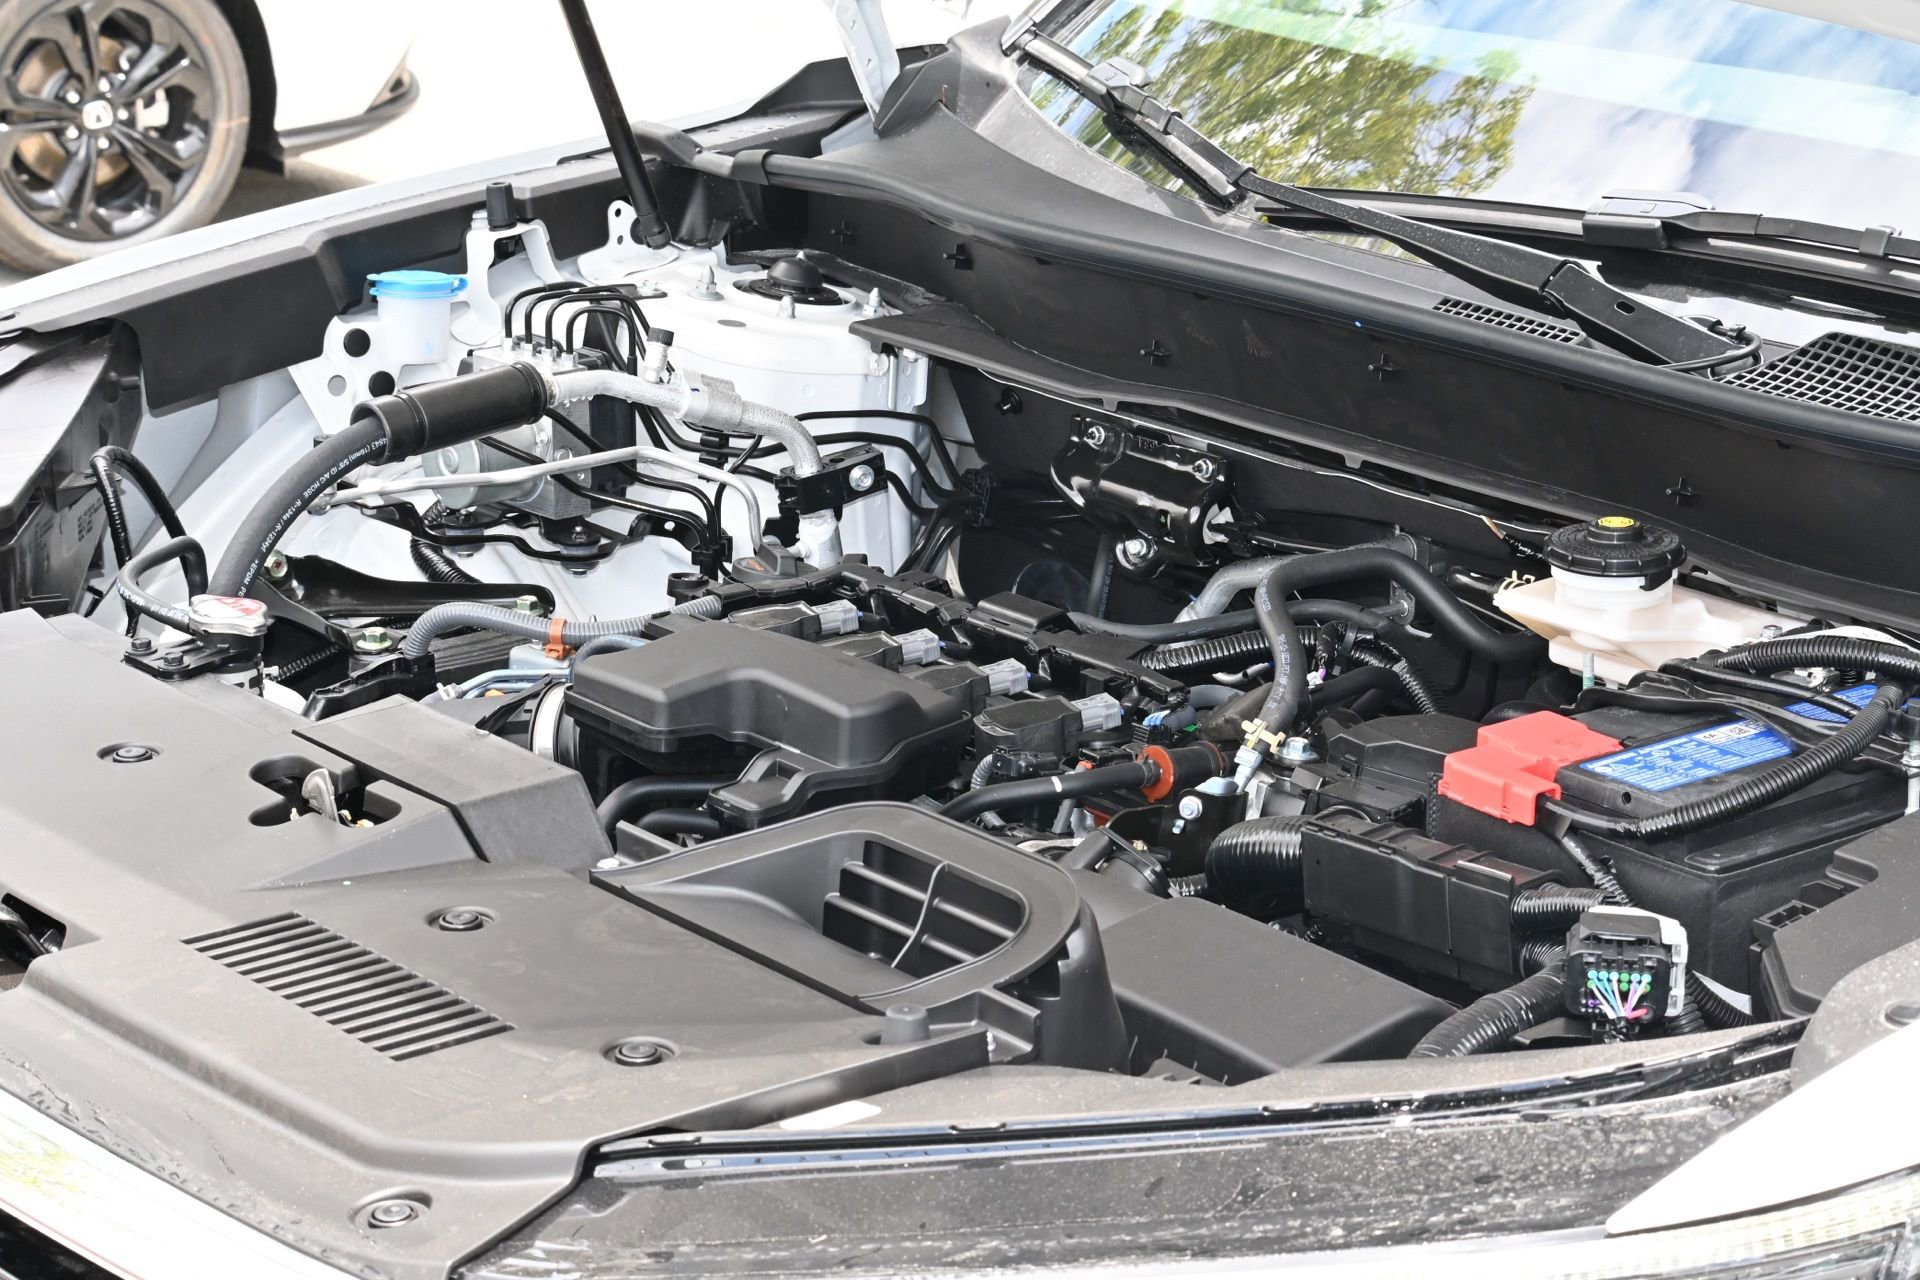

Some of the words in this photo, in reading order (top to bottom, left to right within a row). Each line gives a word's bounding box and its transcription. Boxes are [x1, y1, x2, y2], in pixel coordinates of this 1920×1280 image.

[319, 472, 330, 484] A/C
[330, 466, 338, 475] ID
[303, 480, 321, 499] HOSE
[282, 498, 302, 521] R-134a
[261, 522, 283, 553] R-1234yf
